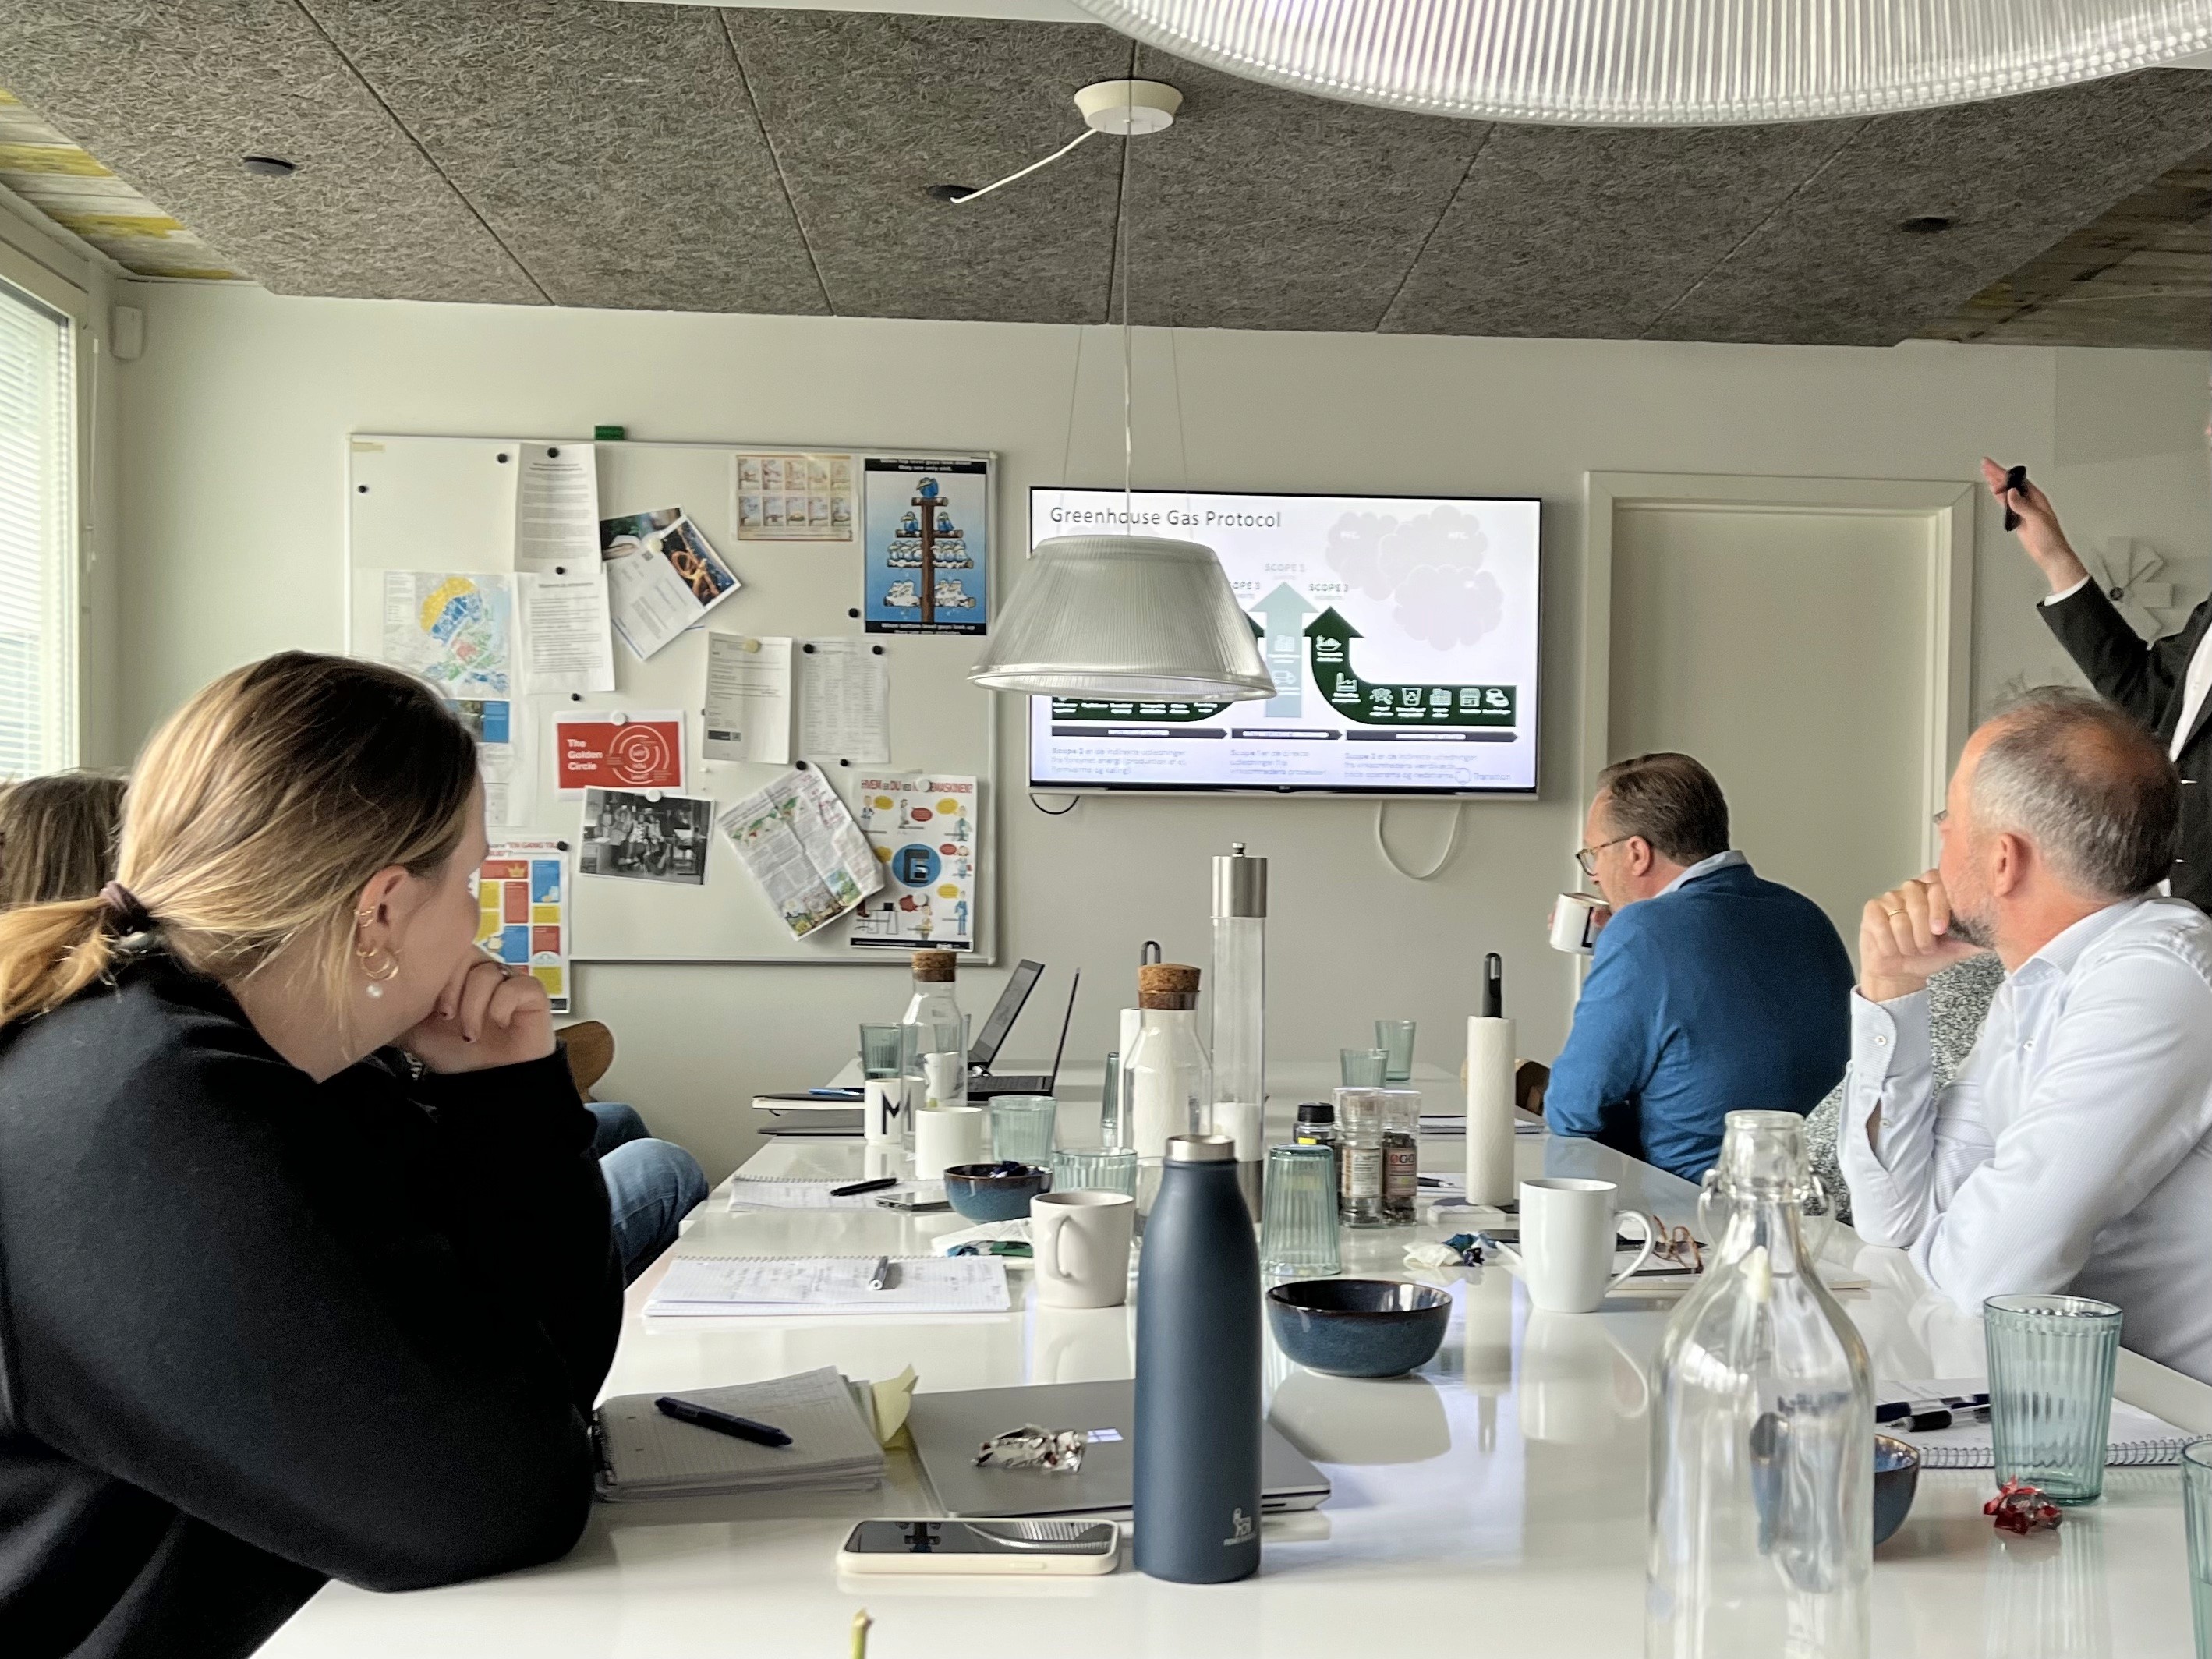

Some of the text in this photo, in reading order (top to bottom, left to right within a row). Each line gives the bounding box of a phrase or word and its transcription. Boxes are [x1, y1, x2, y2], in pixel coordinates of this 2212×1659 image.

[1050, 507, 1281, 527] Greenhouse Gas Protocol
[1308, 583, 1340, 592] SCOPE
[881, 1088, 911, 1135] M
